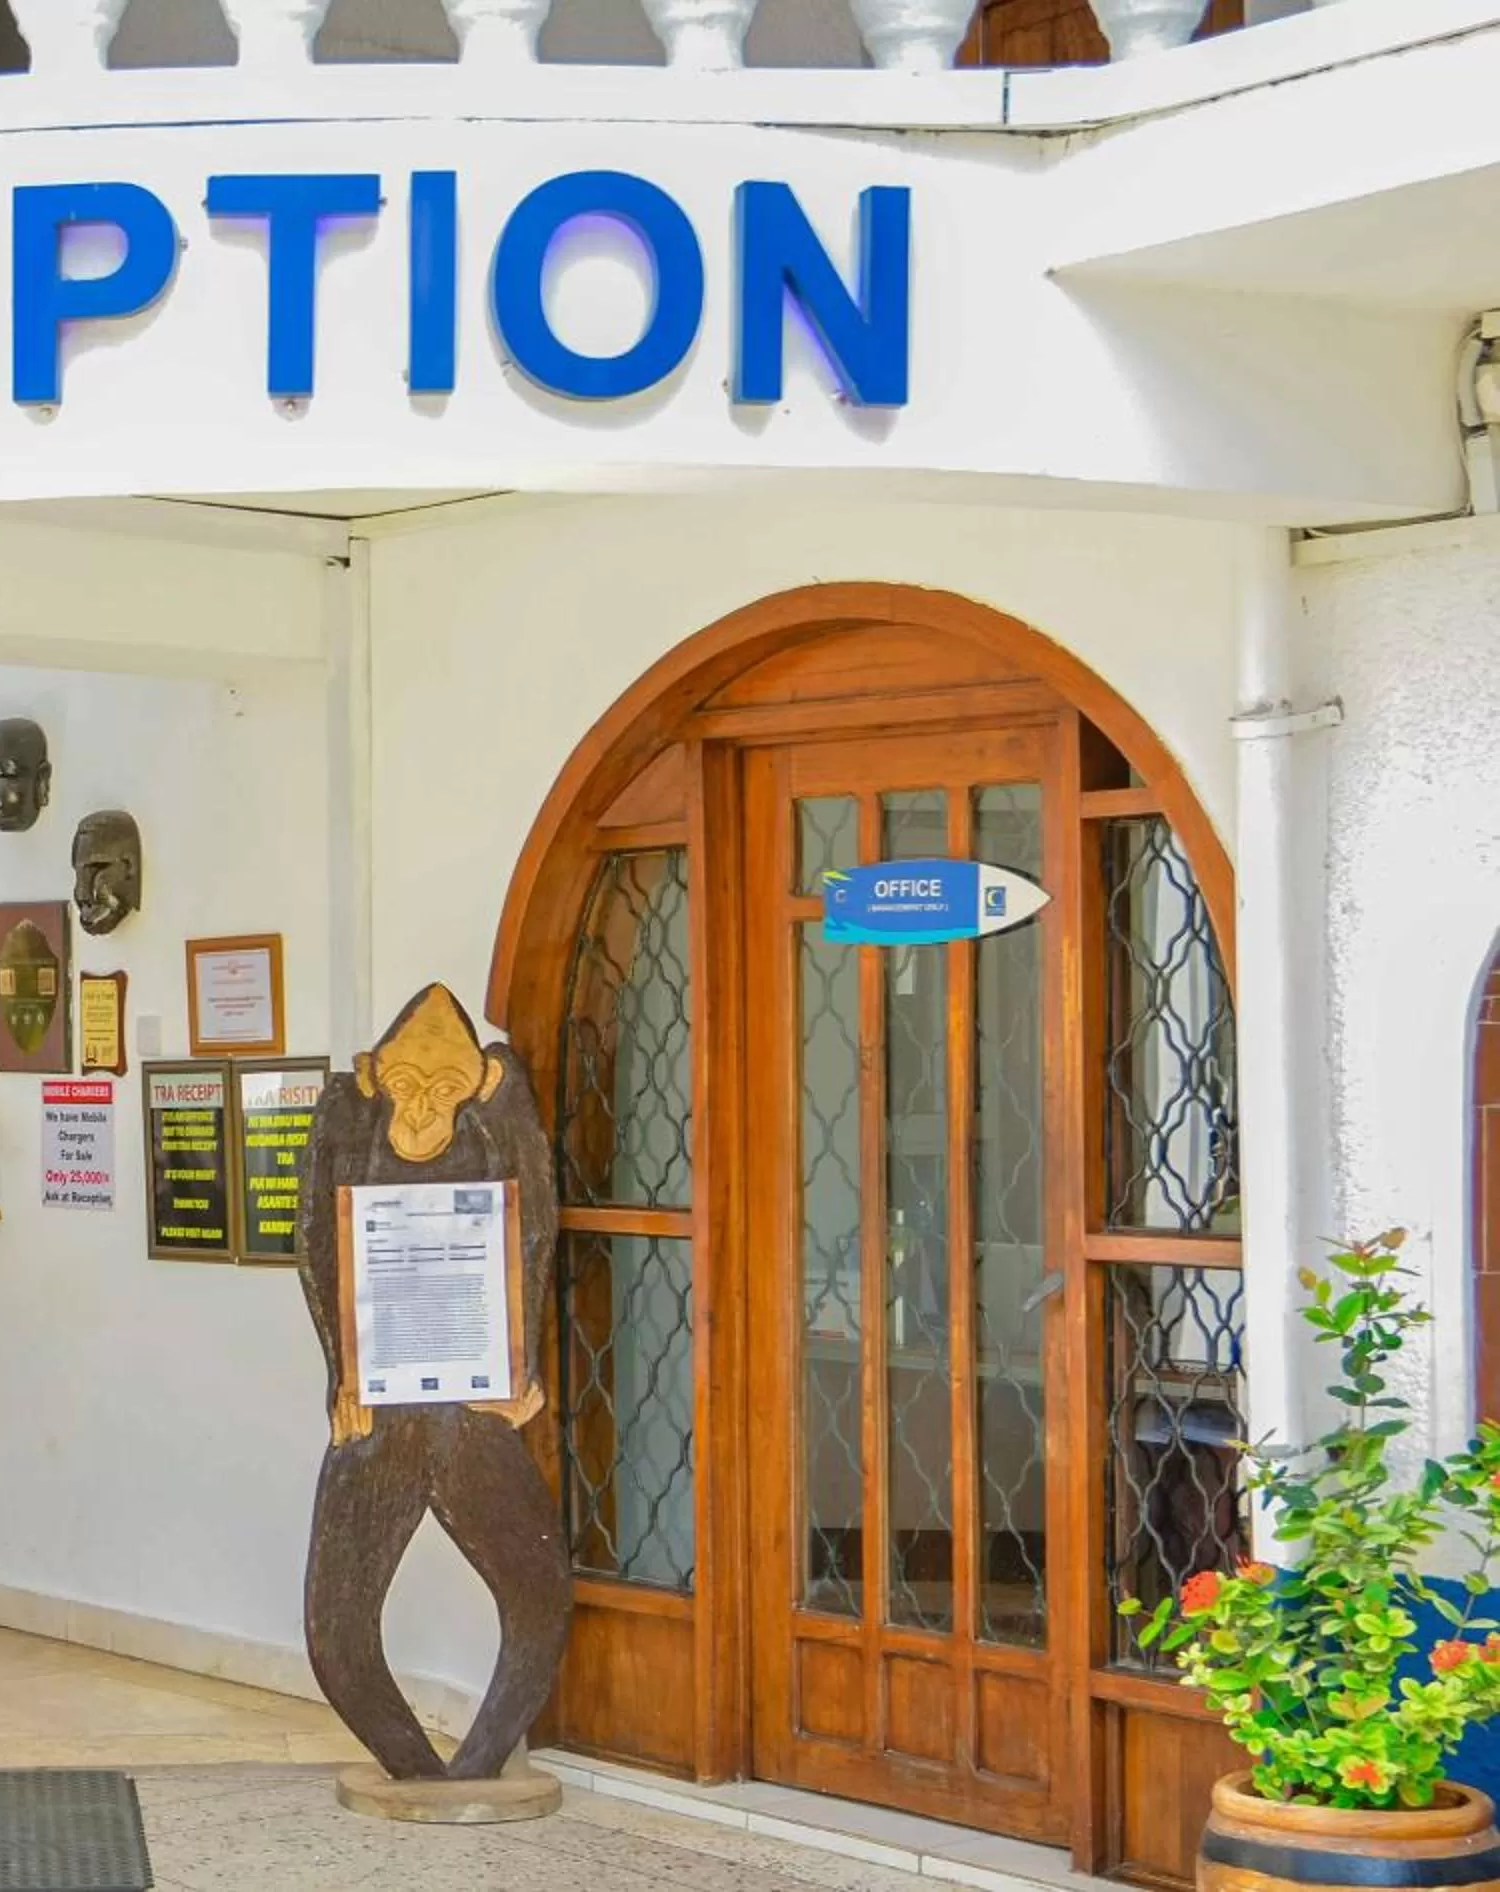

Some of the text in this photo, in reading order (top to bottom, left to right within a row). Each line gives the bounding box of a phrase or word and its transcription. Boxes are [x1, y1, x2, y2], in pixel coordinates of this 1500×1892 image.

[874, 879, 942, 898] OFFICE
[155, 1083, 225, 1101] TRA RECEIPT
[45, 1111, 107, 1123] We have Mobile
[58, 1130, 95, 1144] Chargers
[60, 1149, 93, 1161] For Sale
[276, 1152, 295, 1165] TRA
[45, 1170, 67, 1186] Only
[71, 1192, 112, 1206] Reception
